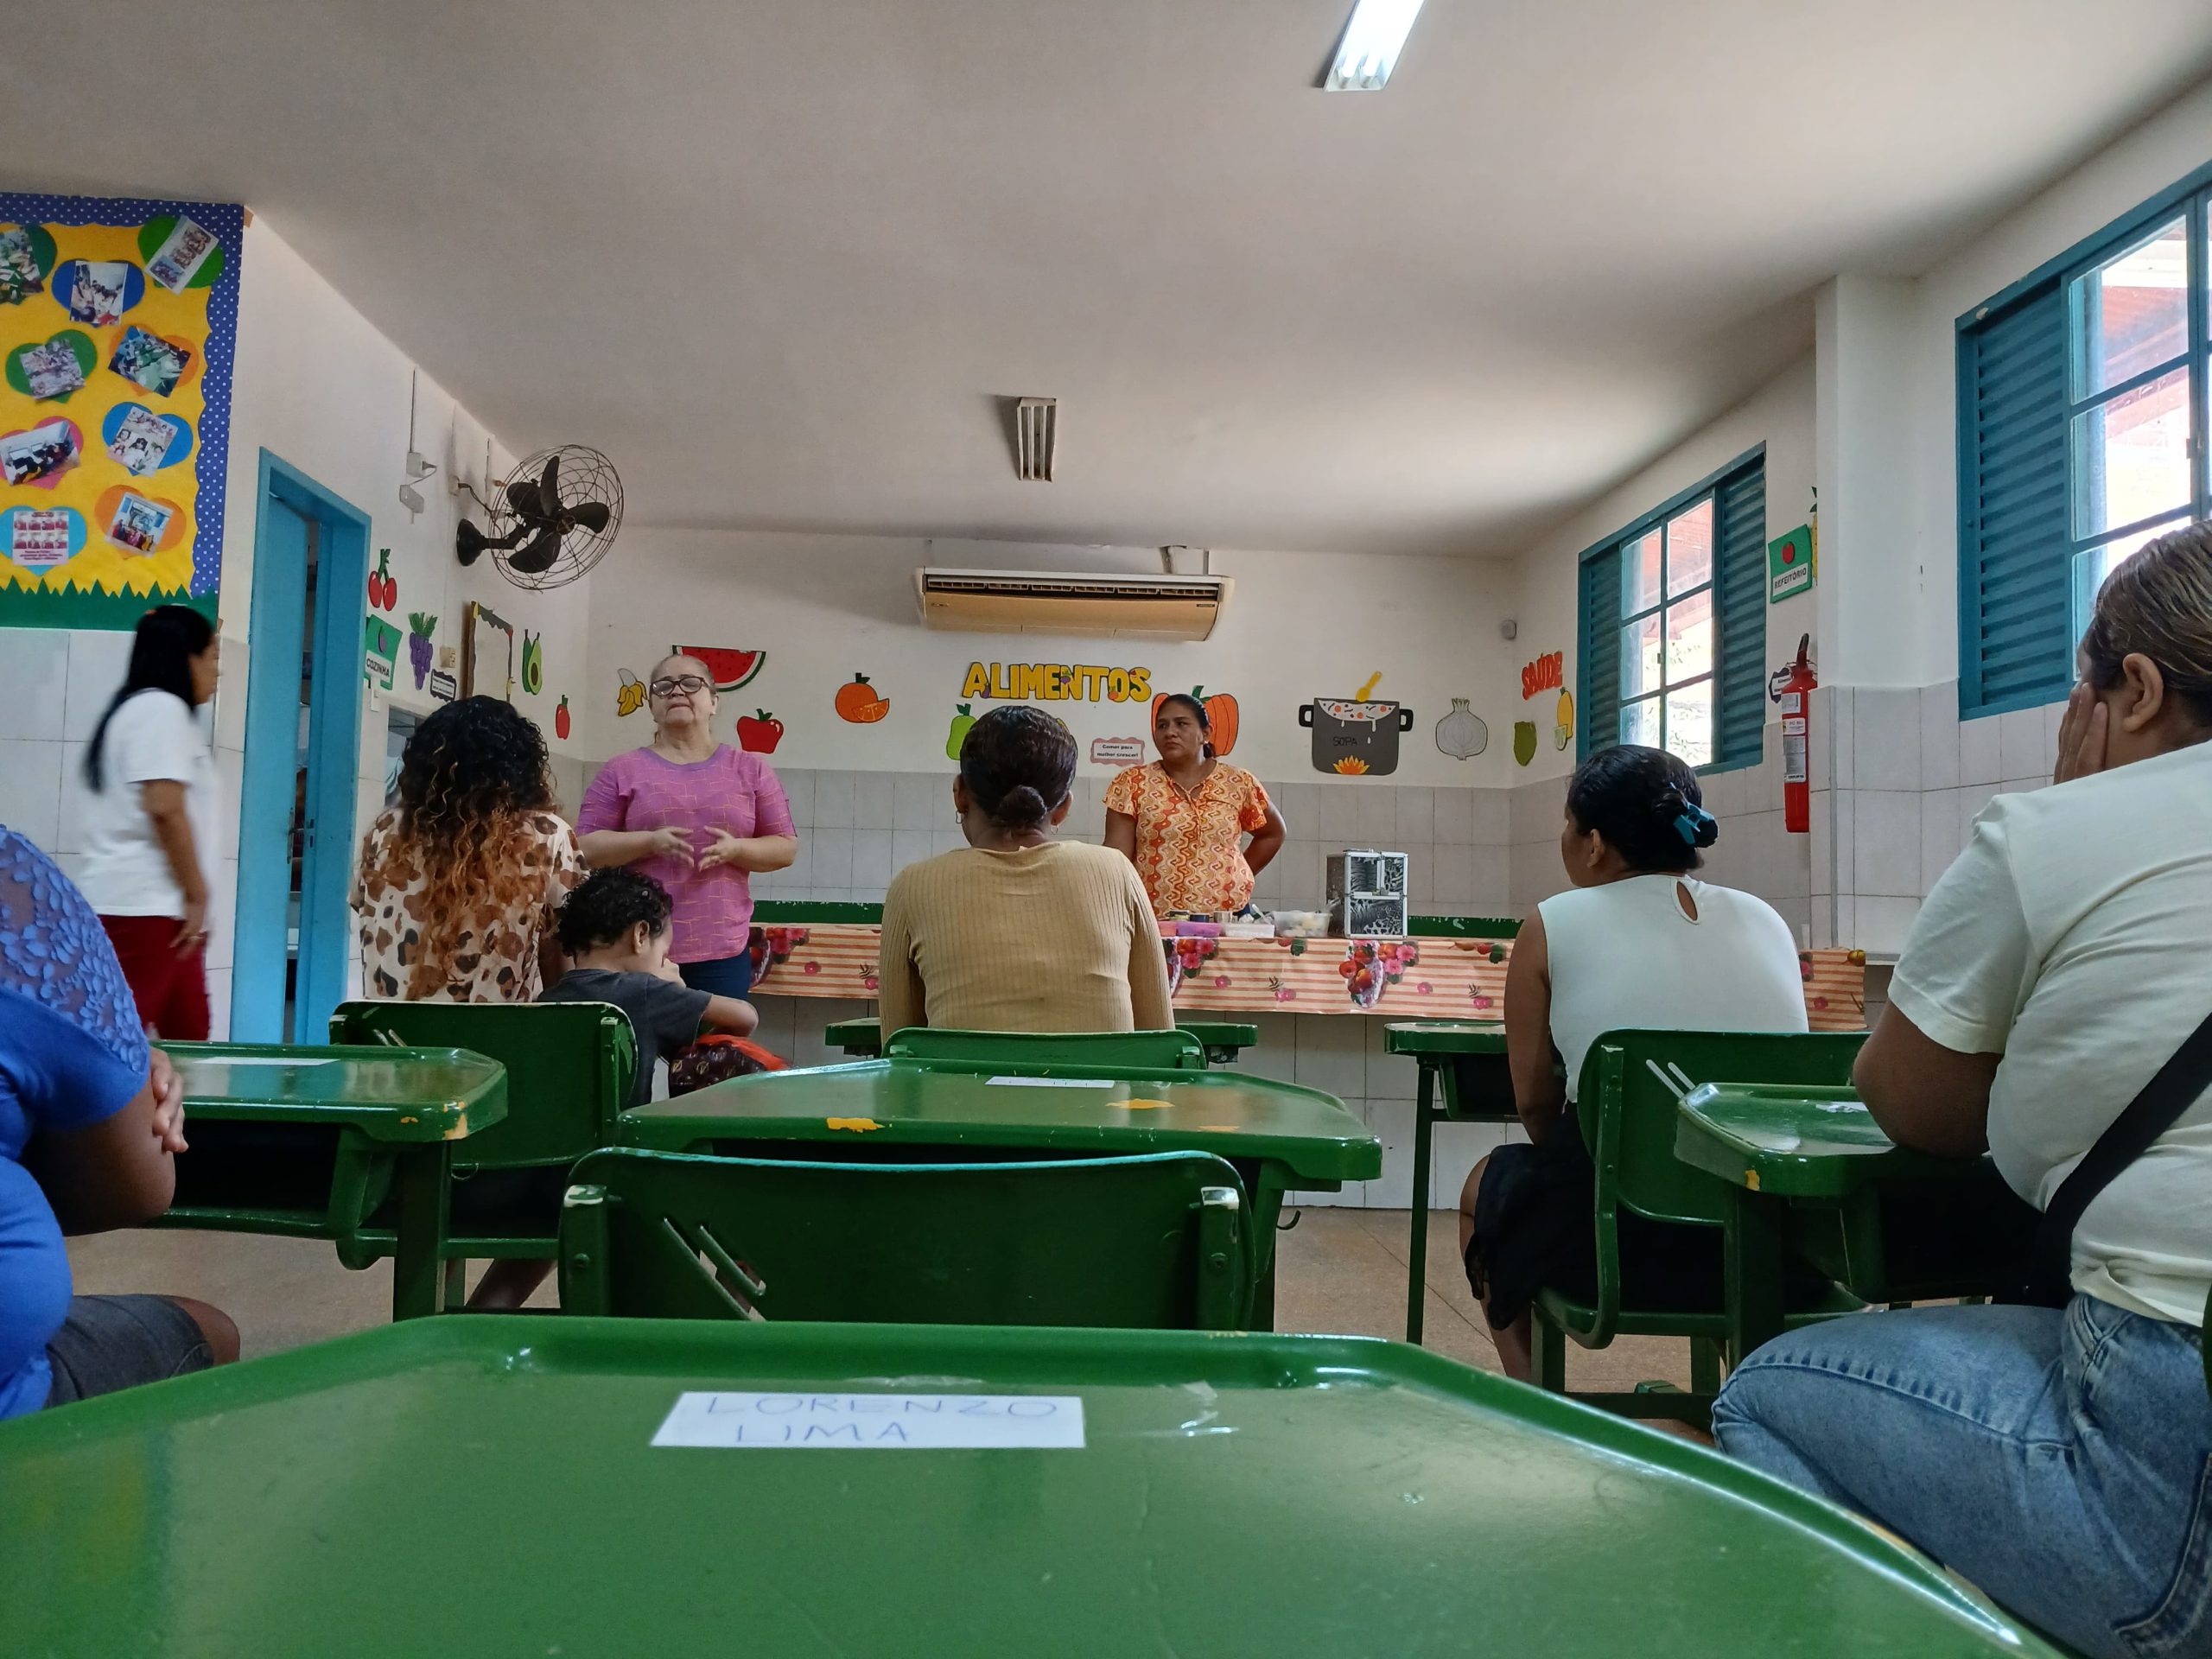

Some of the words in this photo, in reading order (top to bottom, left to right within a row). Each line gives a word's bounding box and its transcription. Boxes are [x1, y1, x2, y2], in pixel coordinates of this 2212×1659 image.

[1774, 567, 1807, 588] REFEITÓRIO
[366, 658, 390, 677] COZINHA
[1522, 651, 1563, 701] SAÚDE
[962, 662, 1152, 702] ALIMENTOS
[1332, 736, 1357, 747] SOPA
[708, 1396, 1057, 1417] LORENZO
[736, 1421, 907, 1442] LIMA
